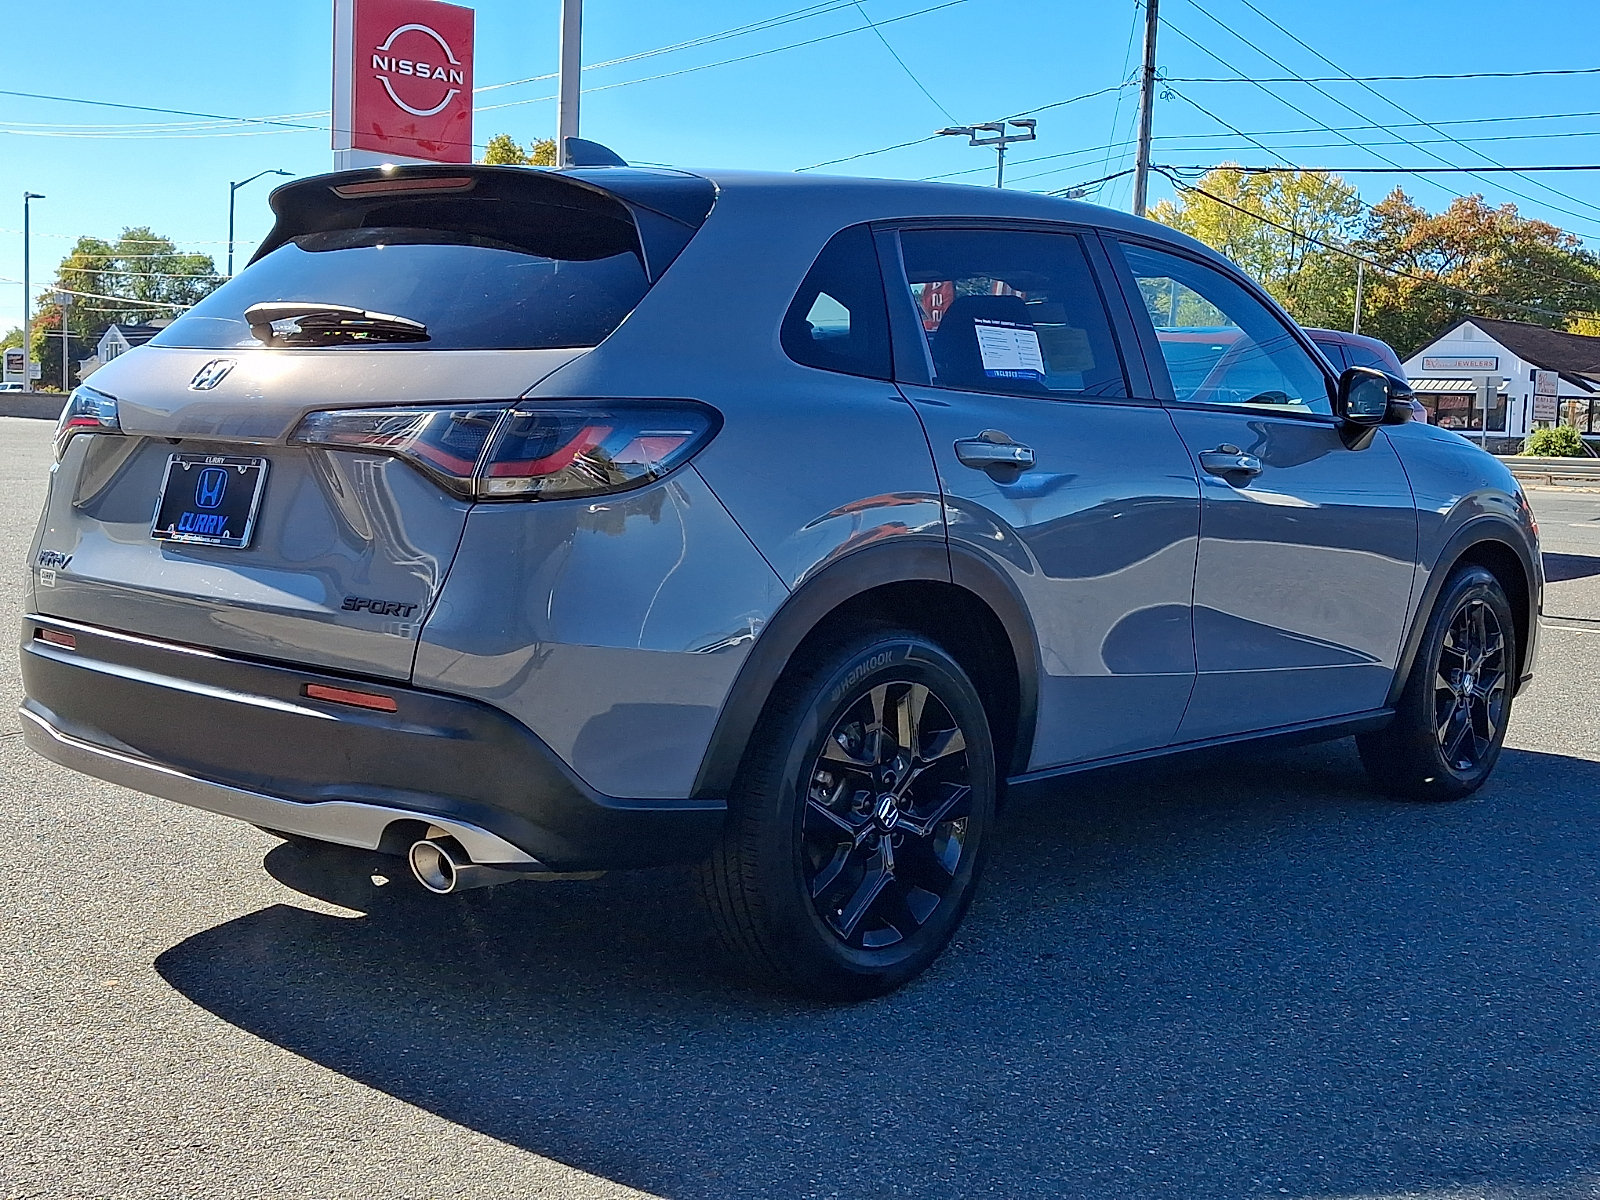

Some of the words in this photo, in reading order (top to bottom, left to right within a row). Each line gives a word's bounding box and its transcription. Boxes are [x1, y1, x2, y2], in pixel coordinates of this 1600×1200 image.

[372, 54, 464, 84] NISSAN
[1454, 360, 1493, 368] JEWELERS
[205, 456, 226, 465] CURRY
[178, 512, 228, 534] CURRY
[341, 596, 417, 617] SPORT
